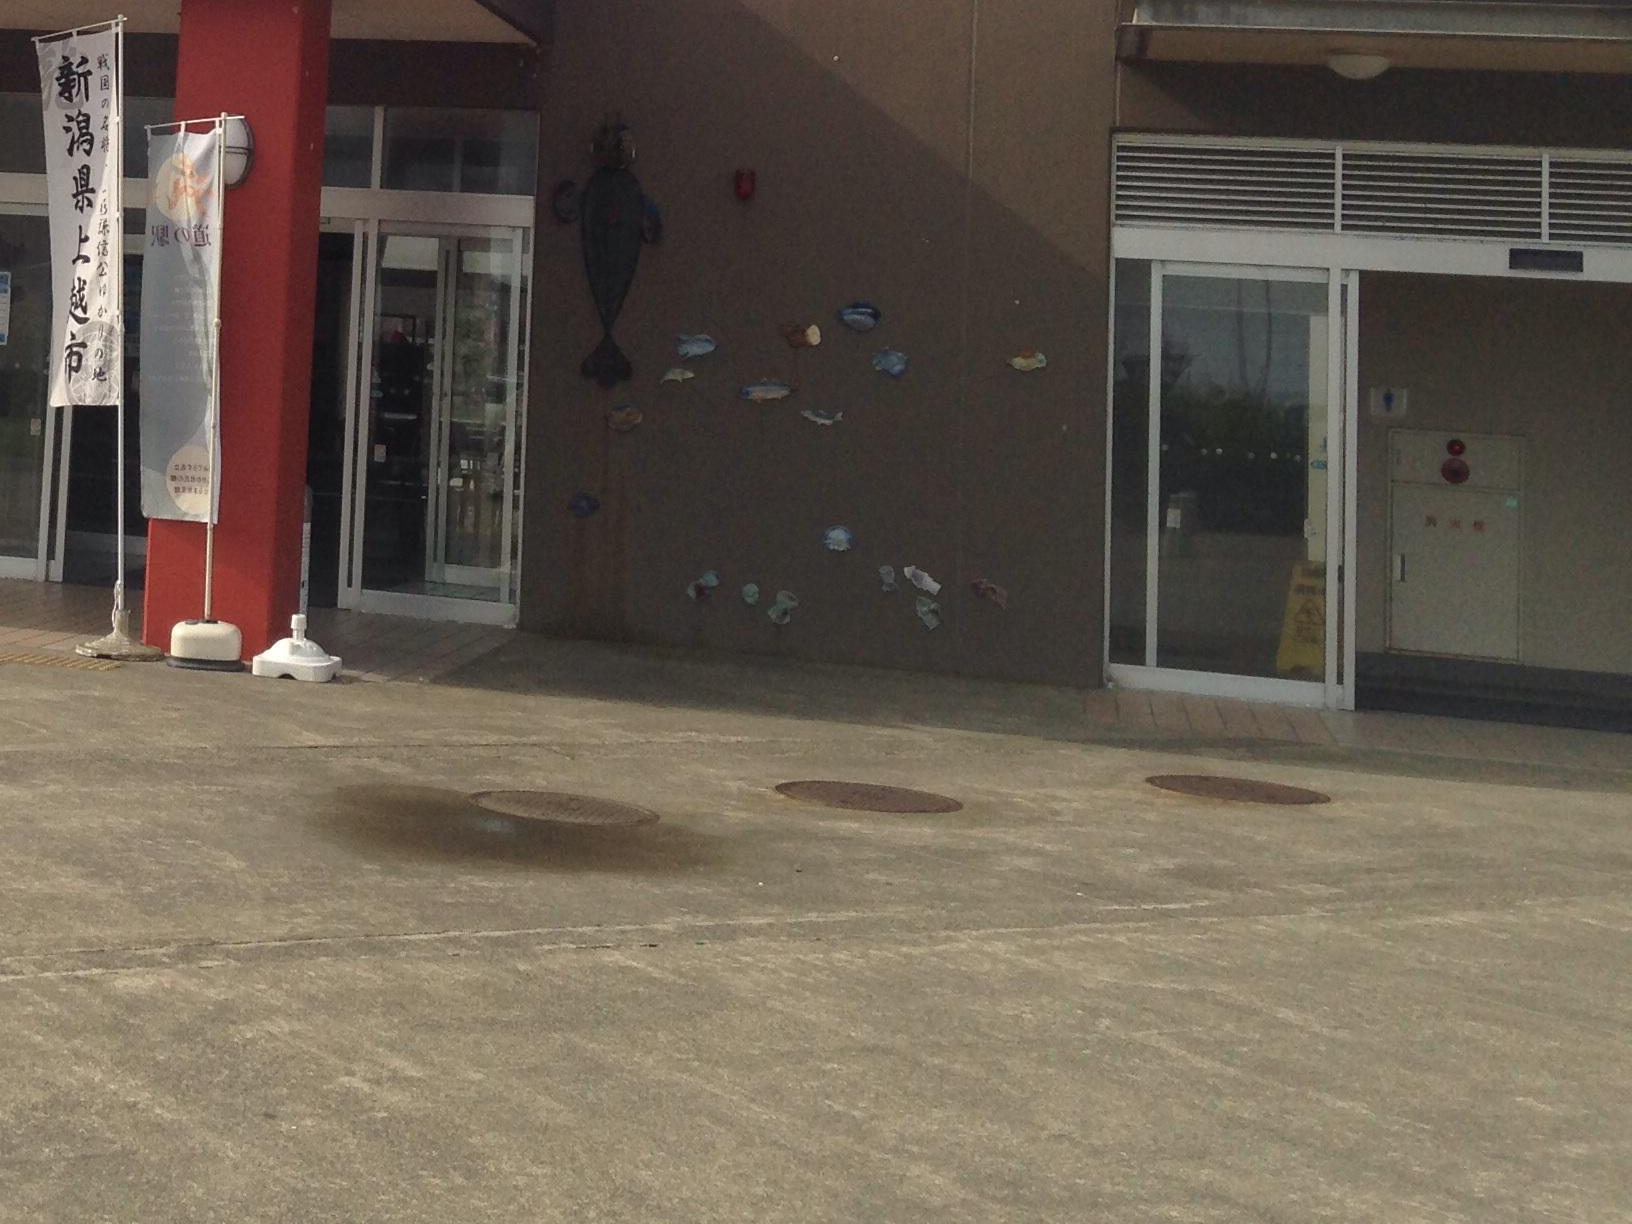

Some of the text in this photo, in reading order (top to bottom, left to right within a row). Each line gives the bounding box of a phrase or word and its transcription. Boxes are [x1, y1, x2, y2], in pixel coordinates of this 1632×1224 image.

[55, 55, 96, 385] 新潟県上越市
